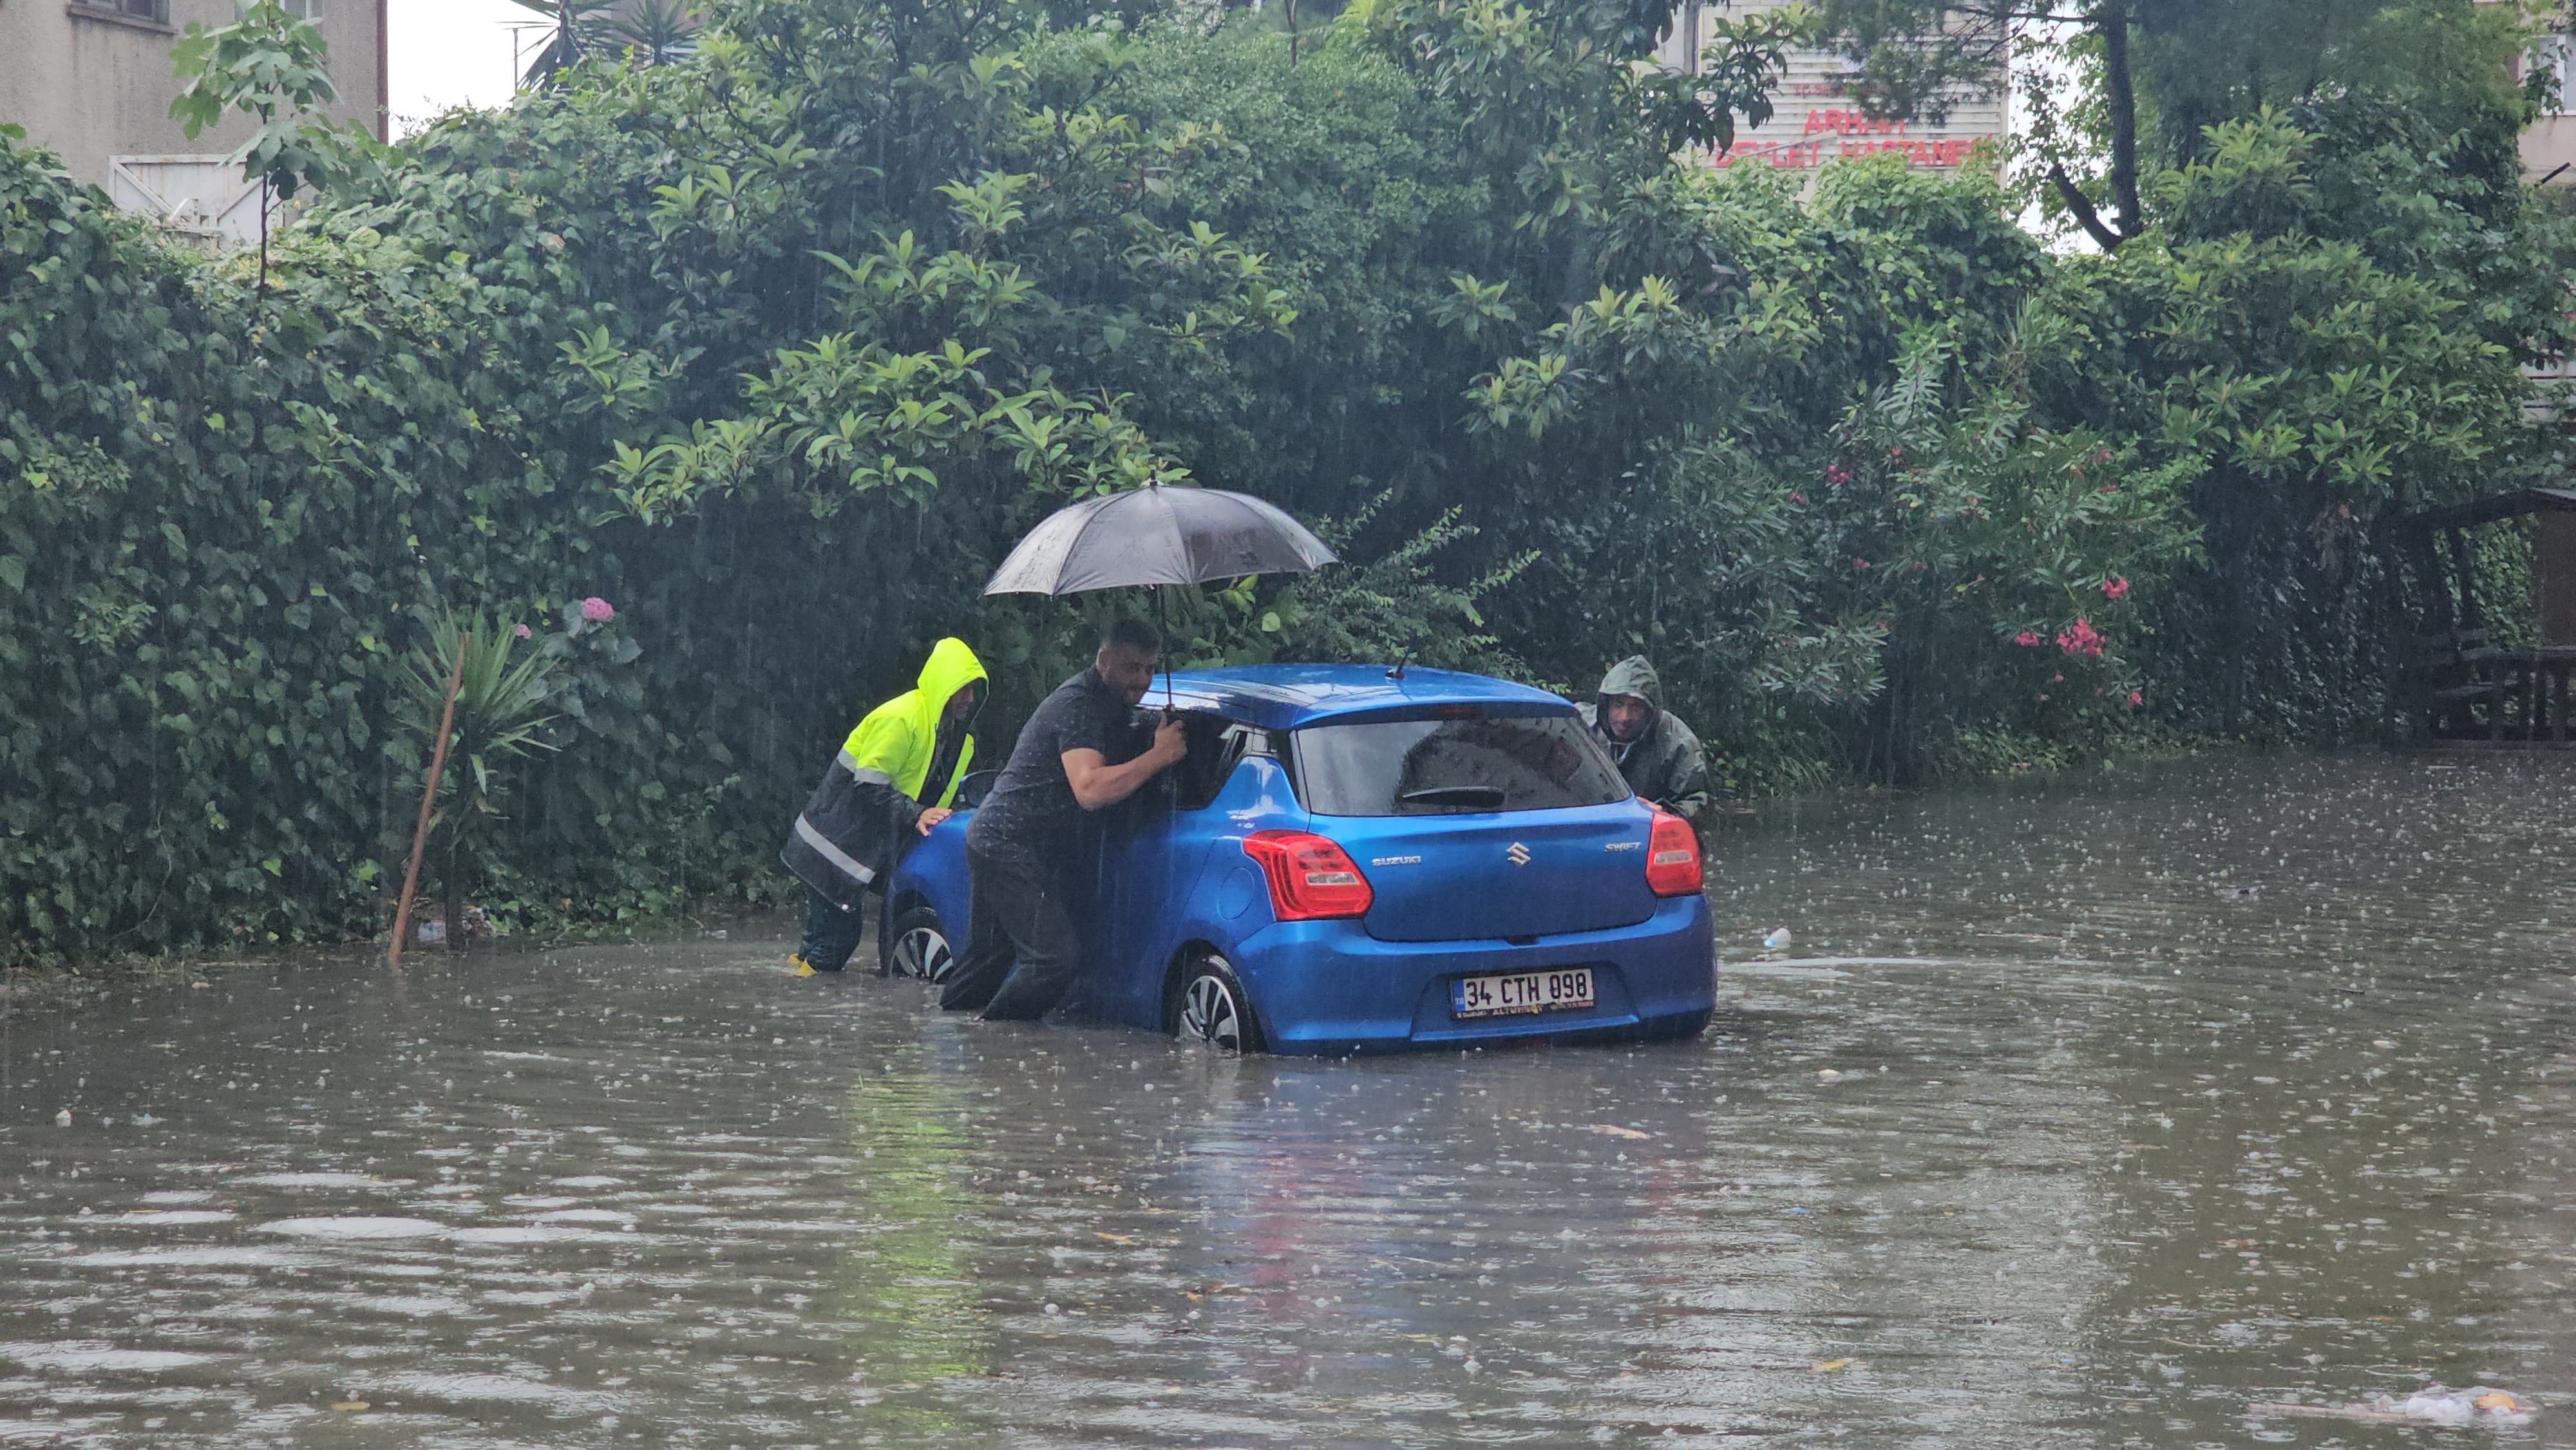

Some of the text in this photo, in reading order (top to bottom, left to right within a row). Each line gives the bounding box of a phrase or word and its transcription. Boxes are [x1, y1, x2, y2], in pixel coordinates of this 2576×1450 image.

[1841, 133, 1992, 165] HATANE
[1604, 842, 1642, 852] SWIFT
[1372, 856, 1421, 866] SUZUKI
[1466, 972, 1587, 1007] 34 CTH 098
